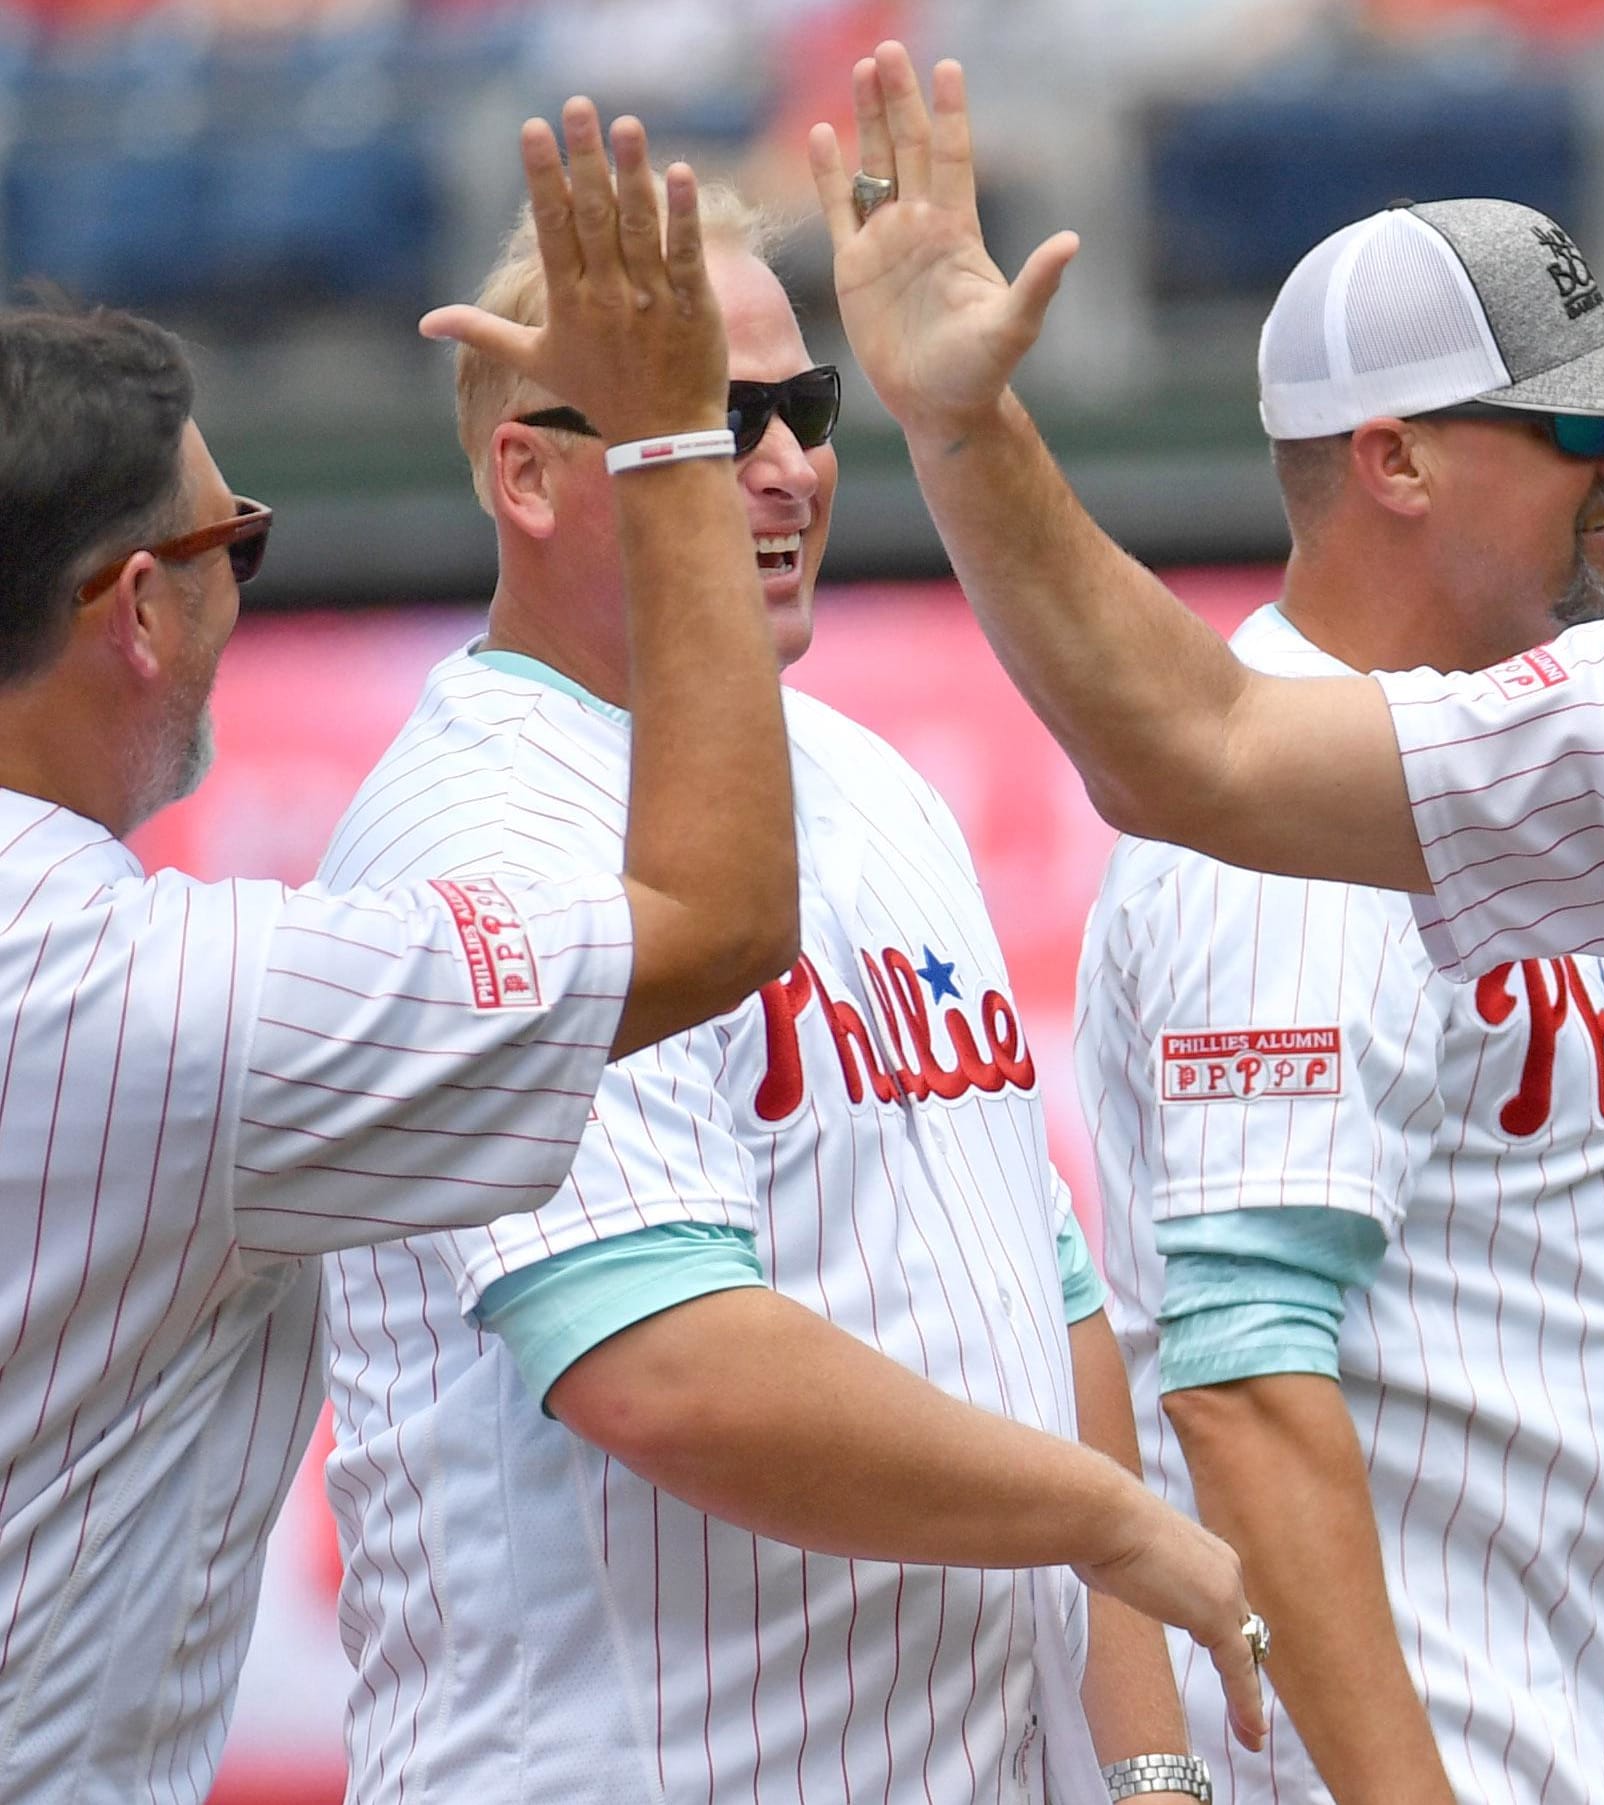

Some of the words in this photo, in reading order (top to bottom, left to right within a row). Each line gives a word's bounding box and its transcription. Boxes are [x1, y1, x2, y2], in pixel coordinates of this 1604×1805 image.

[460, 924, 497, 1004] PHILLIES
[1168, 1034, 1250, 1056] PHILLIES
[1255, 1031, 1335, 1050] ALUMNI
